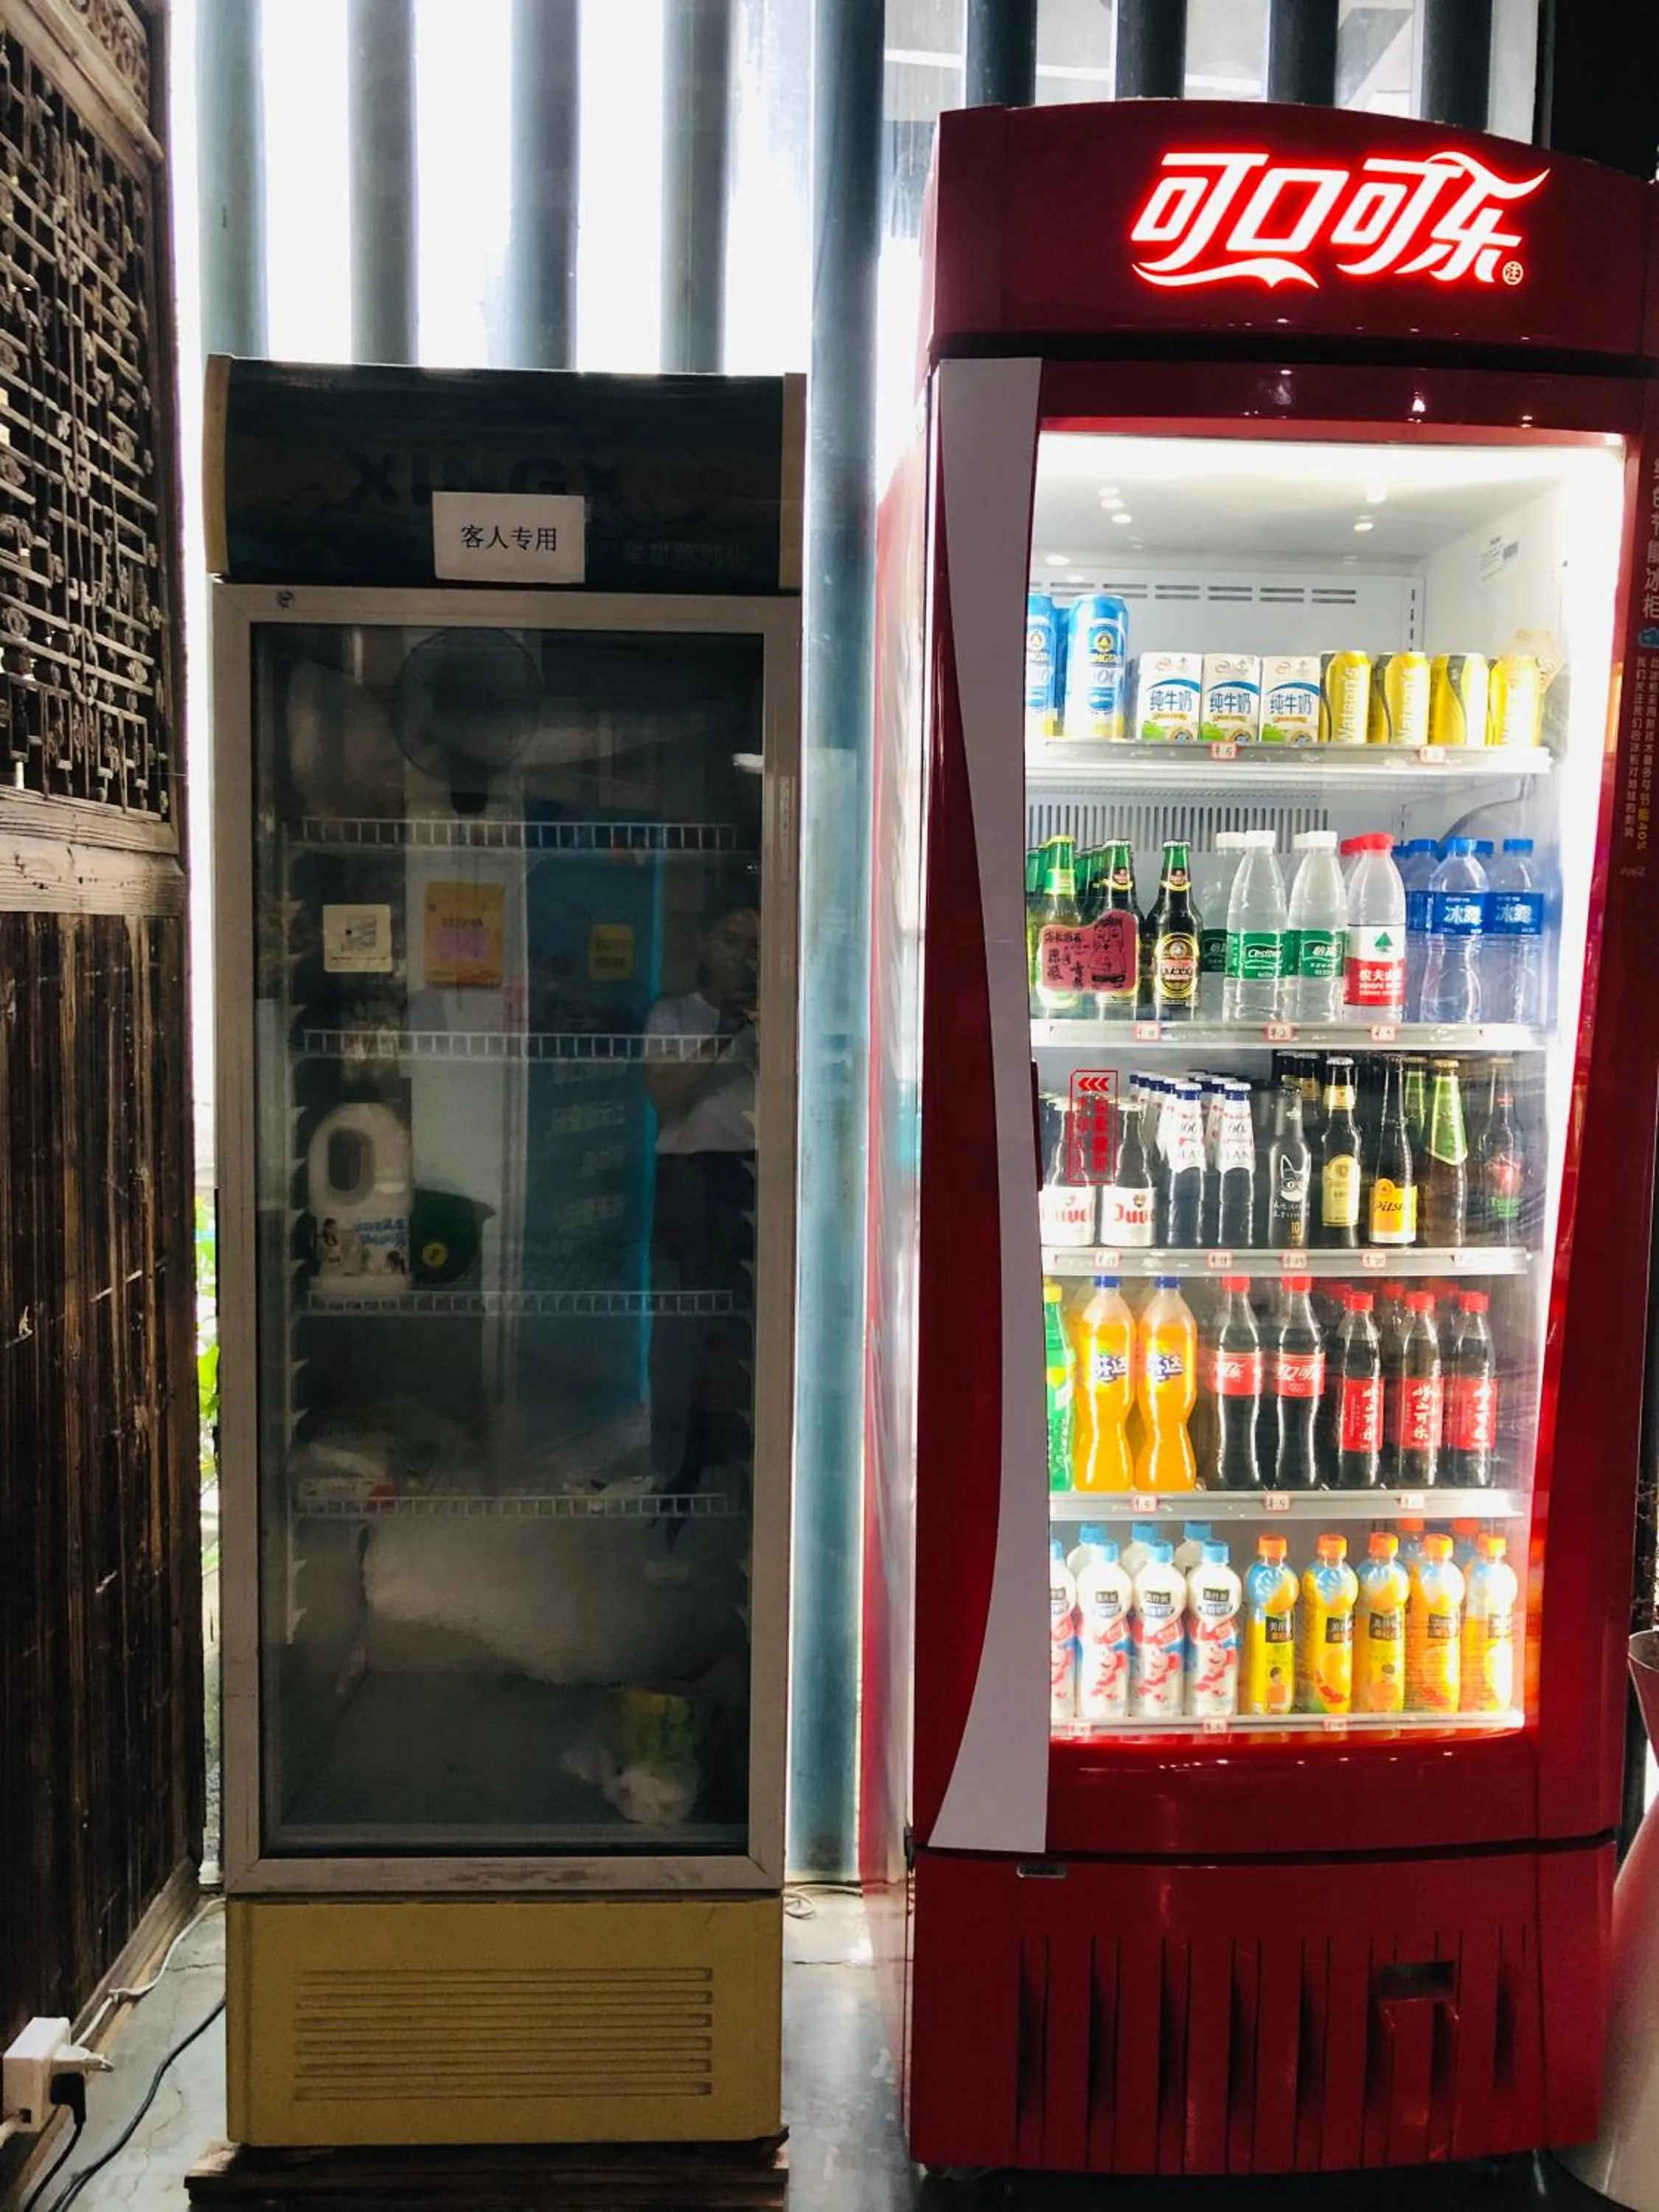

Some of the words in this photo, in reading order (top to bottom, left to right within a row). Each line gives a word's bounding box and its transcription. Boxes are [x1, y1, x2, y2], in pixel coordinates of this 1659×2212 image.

[1130, 151, 1550, 288] 可口可乐
[460, 524, 558, 552] 客人专用
[1150, 690, 1192, 712] 纯牛奶
[1210, 692, 1251, 714] 纯牛奶
[1270, 693, 1312, 715] 纯牛奶
